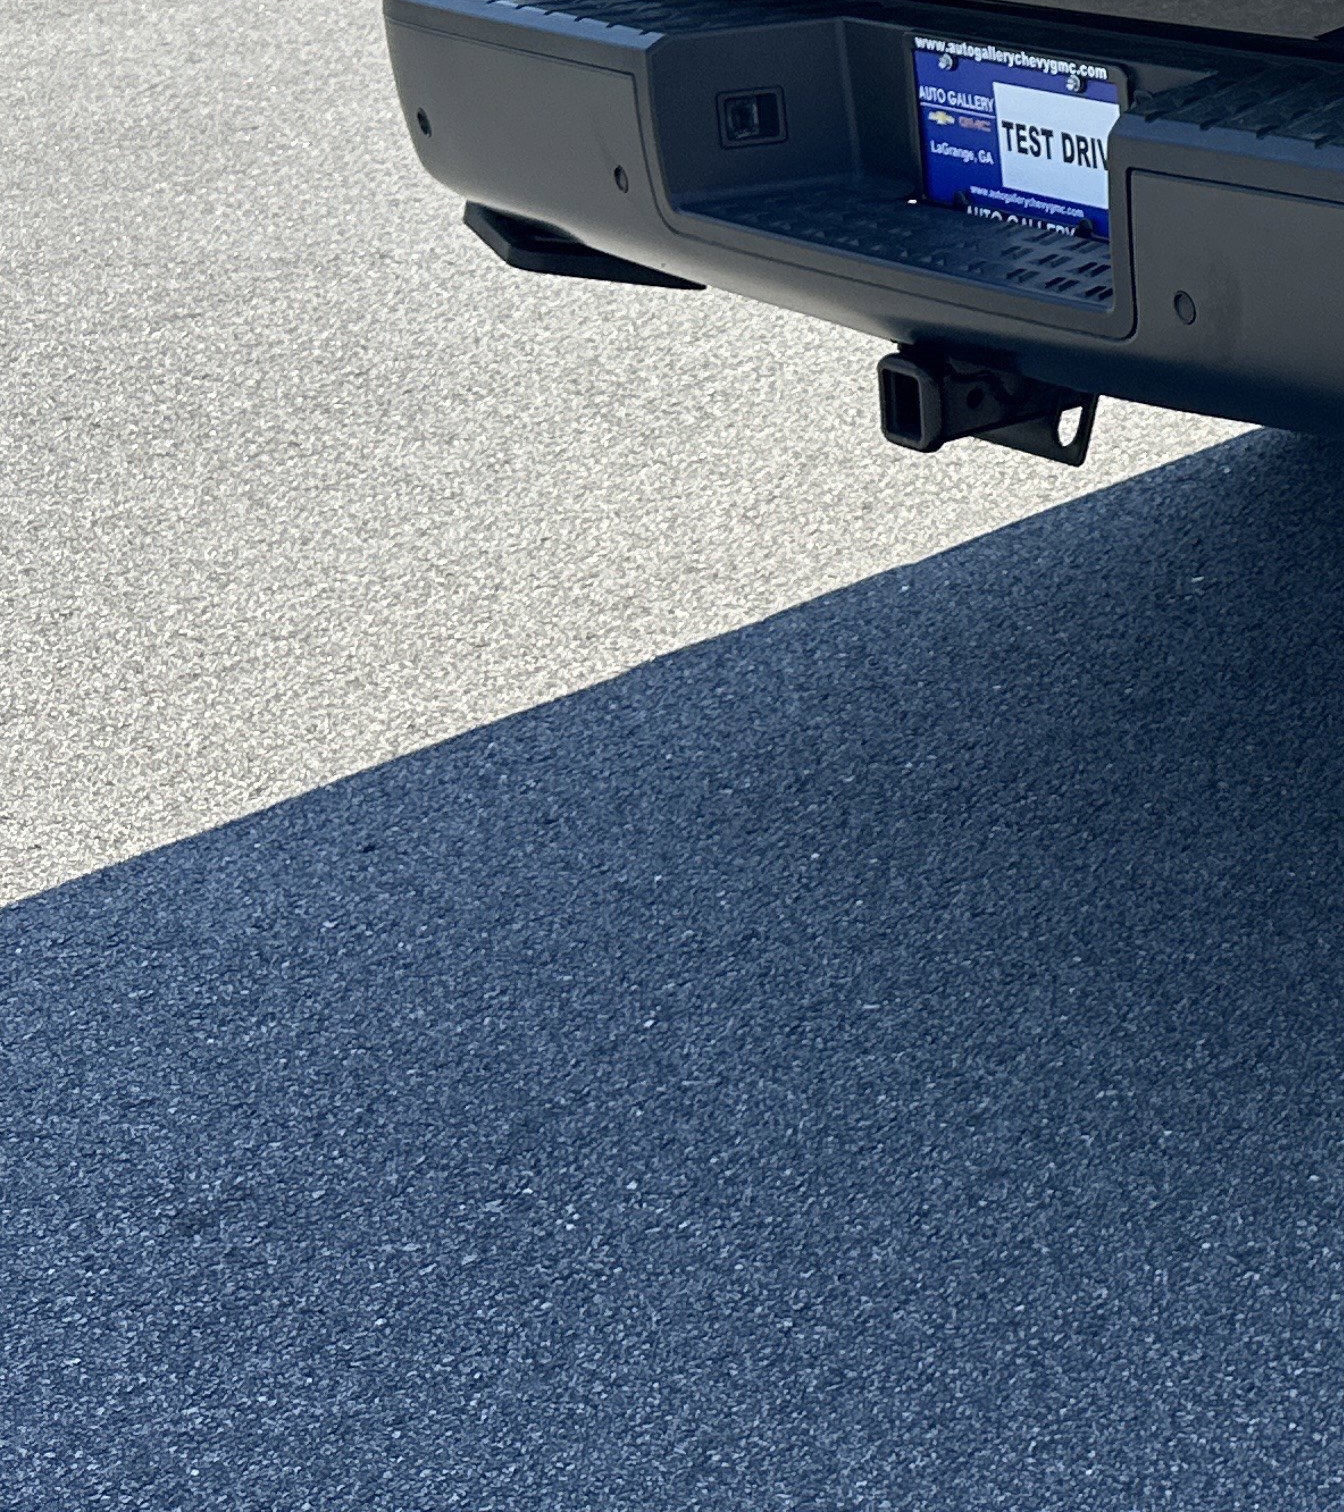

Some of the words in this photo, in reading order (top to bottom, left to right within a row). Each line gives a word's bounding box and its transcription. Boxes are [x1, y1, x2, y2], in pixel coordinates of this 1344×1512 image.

[914, 36, 1108, 79] www.autogallerychevygmc.com
[919, 85, 947, 104] AUTO
[947, 90, 995, 113] GALLERY
[977, 149, 995, 165] GA
[1001, 120, 1054, 160] TEST
